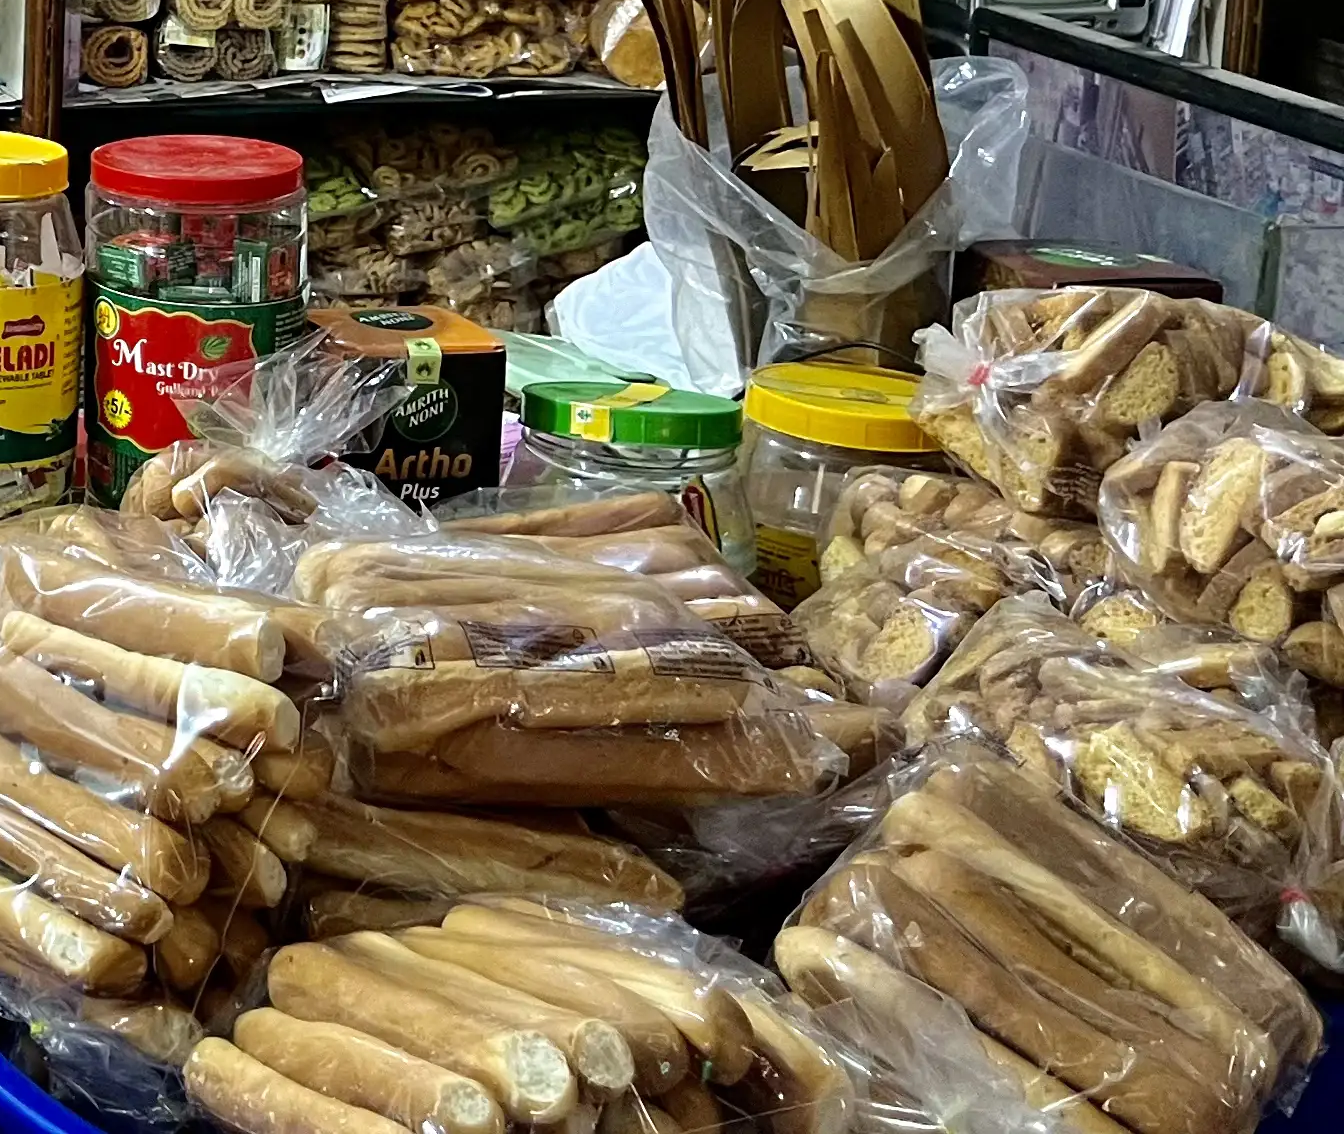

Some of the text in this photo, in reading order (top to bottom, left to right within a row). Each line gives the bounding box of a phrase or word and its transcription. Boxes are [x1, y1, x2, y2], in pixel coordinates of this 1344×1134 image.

[380, 315, 416, 327] NONI
[111, 338, 220, 383] Mast Dry
[394, 387, 450, 418] AMRITH
[408, 401, 445, 428] NONI
[374, 446, 473, 481] Artho
[400, 482, 440, 501] Plus
